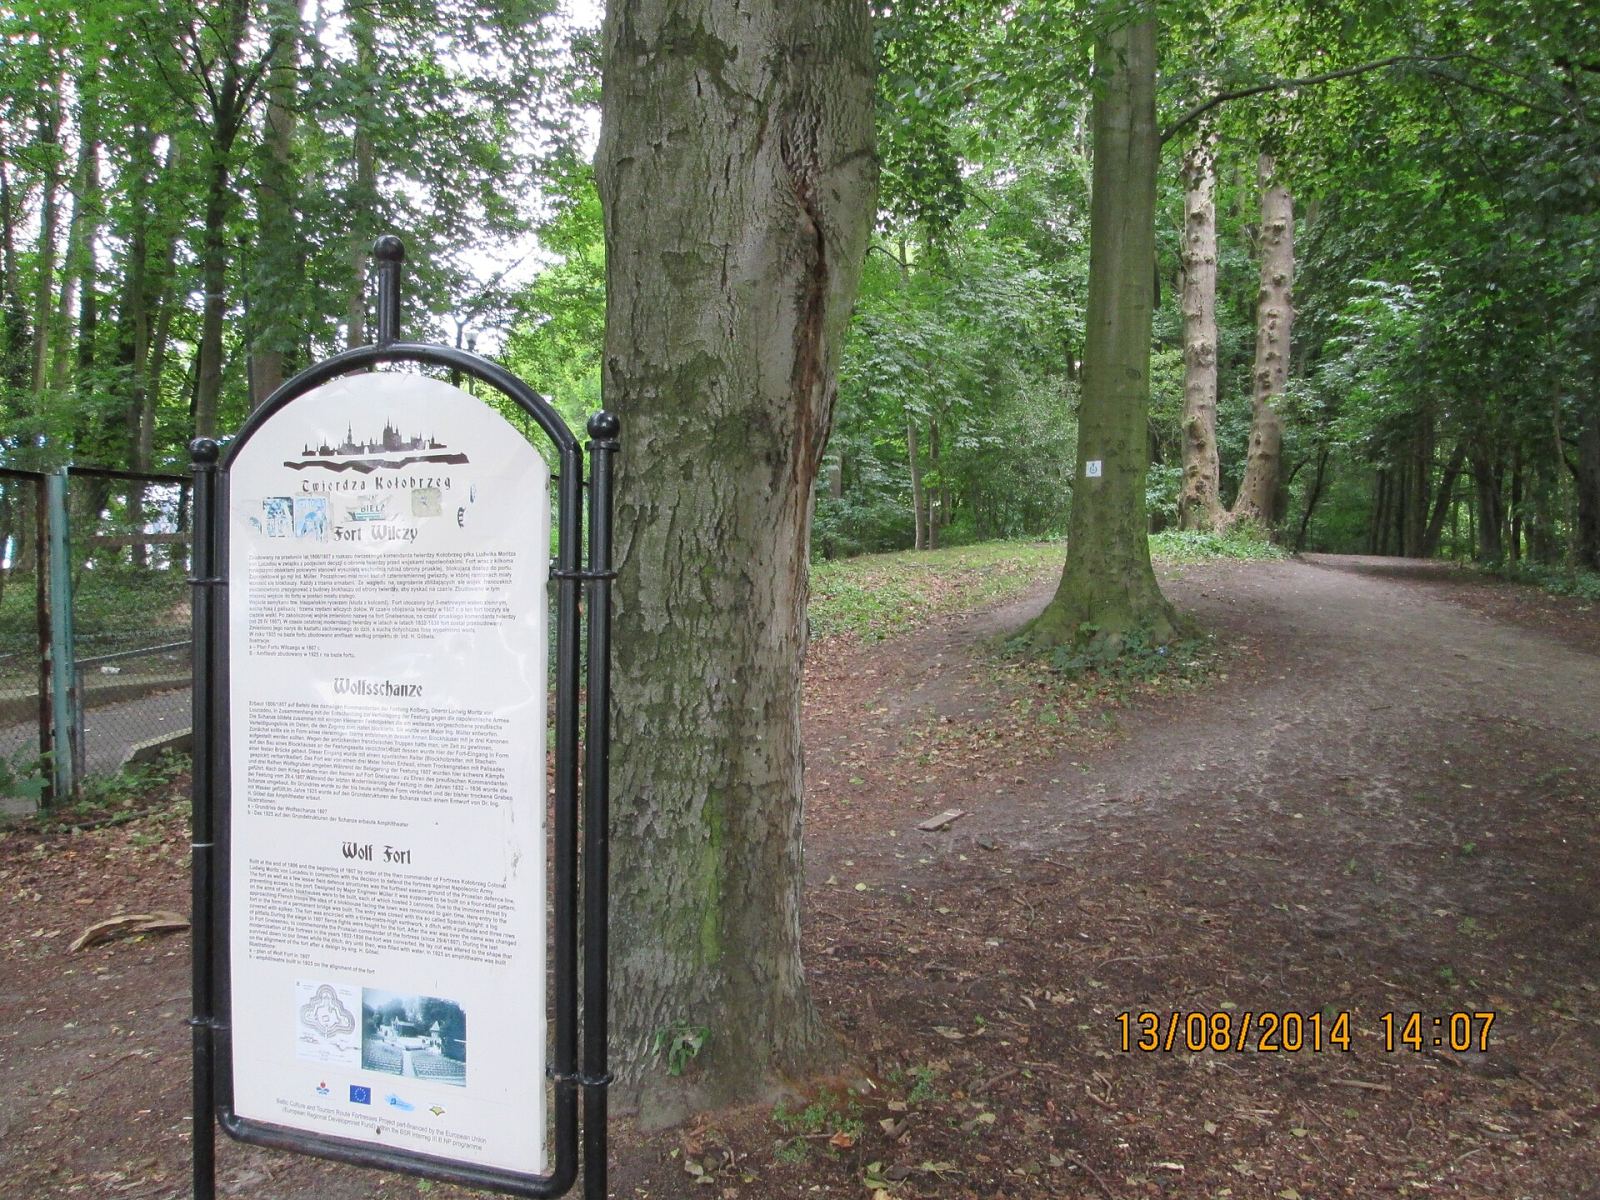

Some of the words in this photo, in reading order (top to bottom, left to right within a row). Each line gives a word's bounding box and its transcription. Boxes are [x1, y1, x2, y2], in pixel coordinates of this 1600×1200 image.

[302, 480, 366, 492] Twierdza
[376, 476, 451, 490] Kołobrzeg
[334, 526, 362, 542] Fort
[371, 525, 418, 543] Wilczy
[334, 678, 423, 697] Wolfsschanze
[342, 842, 373, 861] Wolf
[384, 846, 411, 864] Fort
